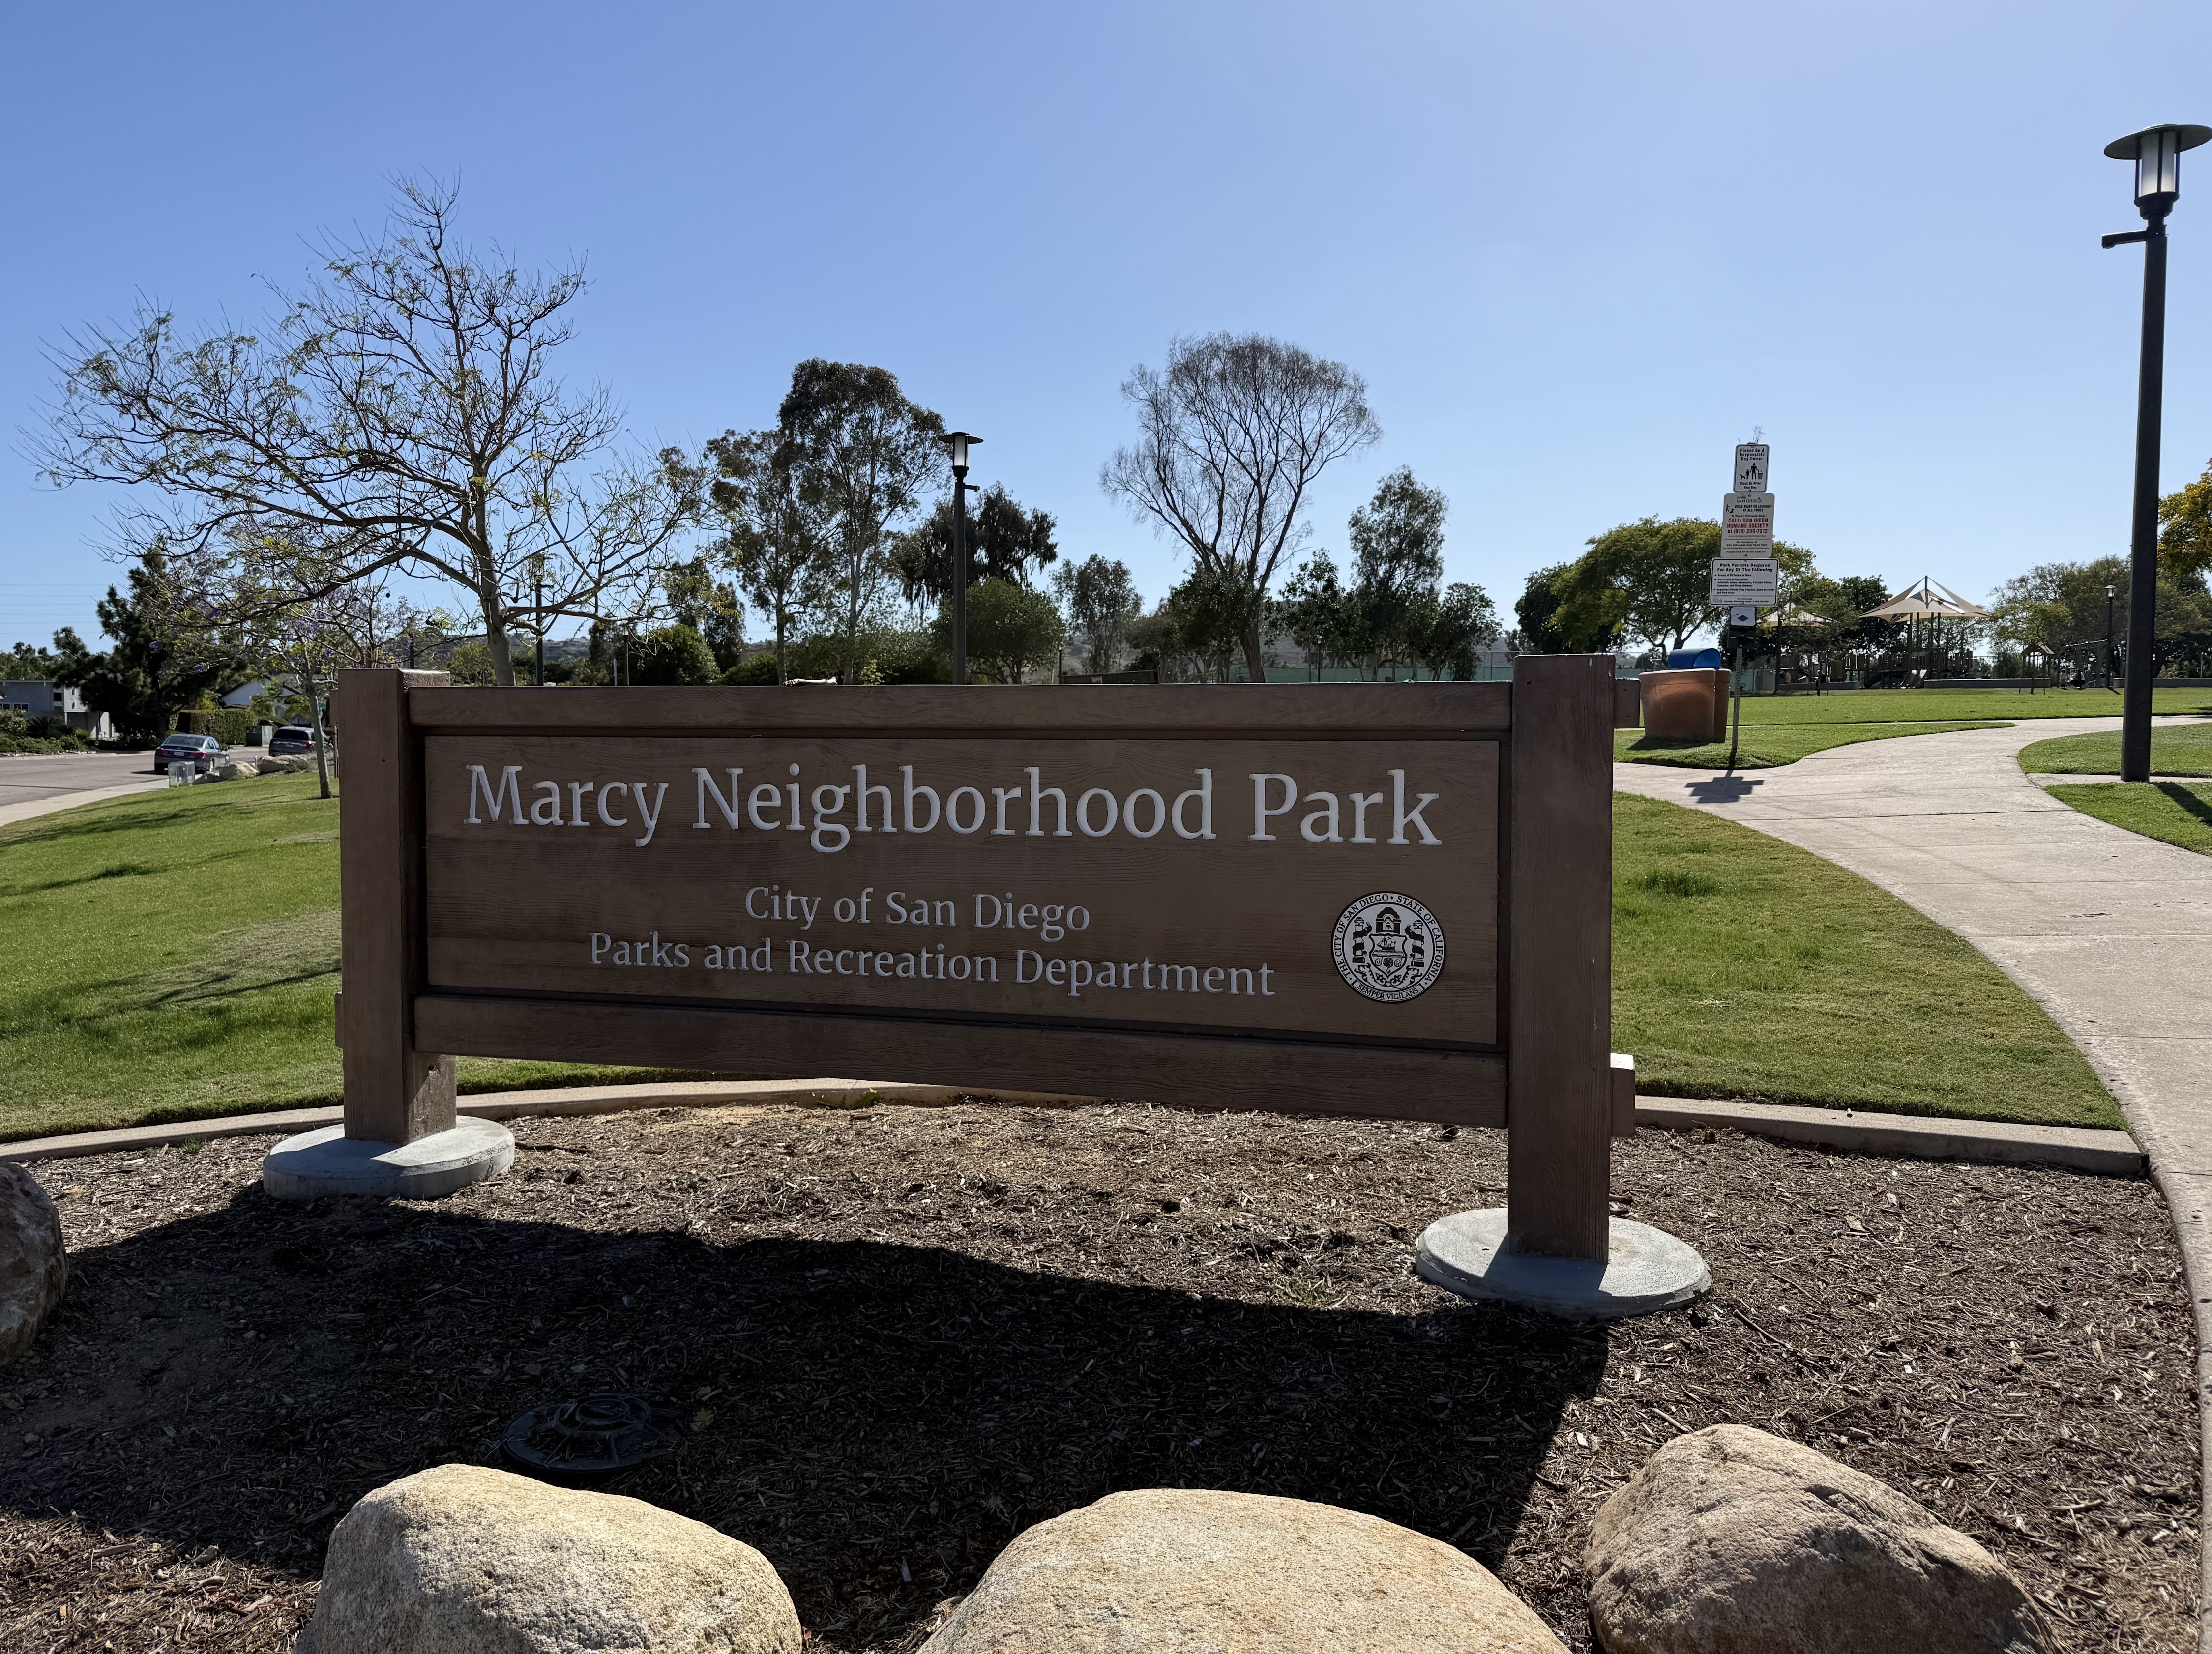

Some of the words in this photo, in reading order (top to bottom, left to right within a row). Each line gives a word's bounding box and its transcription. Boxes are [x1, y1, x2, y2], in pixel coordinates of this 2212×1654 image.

[464, 764, 669, 847] Marcy
[692, 763, 1216, 853] Neighborhood
[1249, 769, 1442, 845] Park
[1358, 894, 1389, 907] DIEGO
[1396, 896, 1425, 915] STATE
[745, 884, 821, 930] City
[834, 887, 874, 923] of
[886, 891, 957, 926] San
[974, 892, 1090, 942] Diego
[1343, 905, 1359, 921] SAN
[1424, 912, 1436, 927] OF
[1336, 922, 1346, 933] OF
[1334, 936, 1342, 957] CITY
[1426, 927, 1444, 982] CALIFORNIA
[590, 931, 690, 968] Parks
[704, 937, 773, 972] and
[788, 940, 1000, 982] Recreation
[1015, 949, 1275, 997] Department
[1337, 959, 1349, 979] THE
[1357, 984, 1385, 1000] SEMPER
[1386, 987, 1419, 1000] VIGILANS
